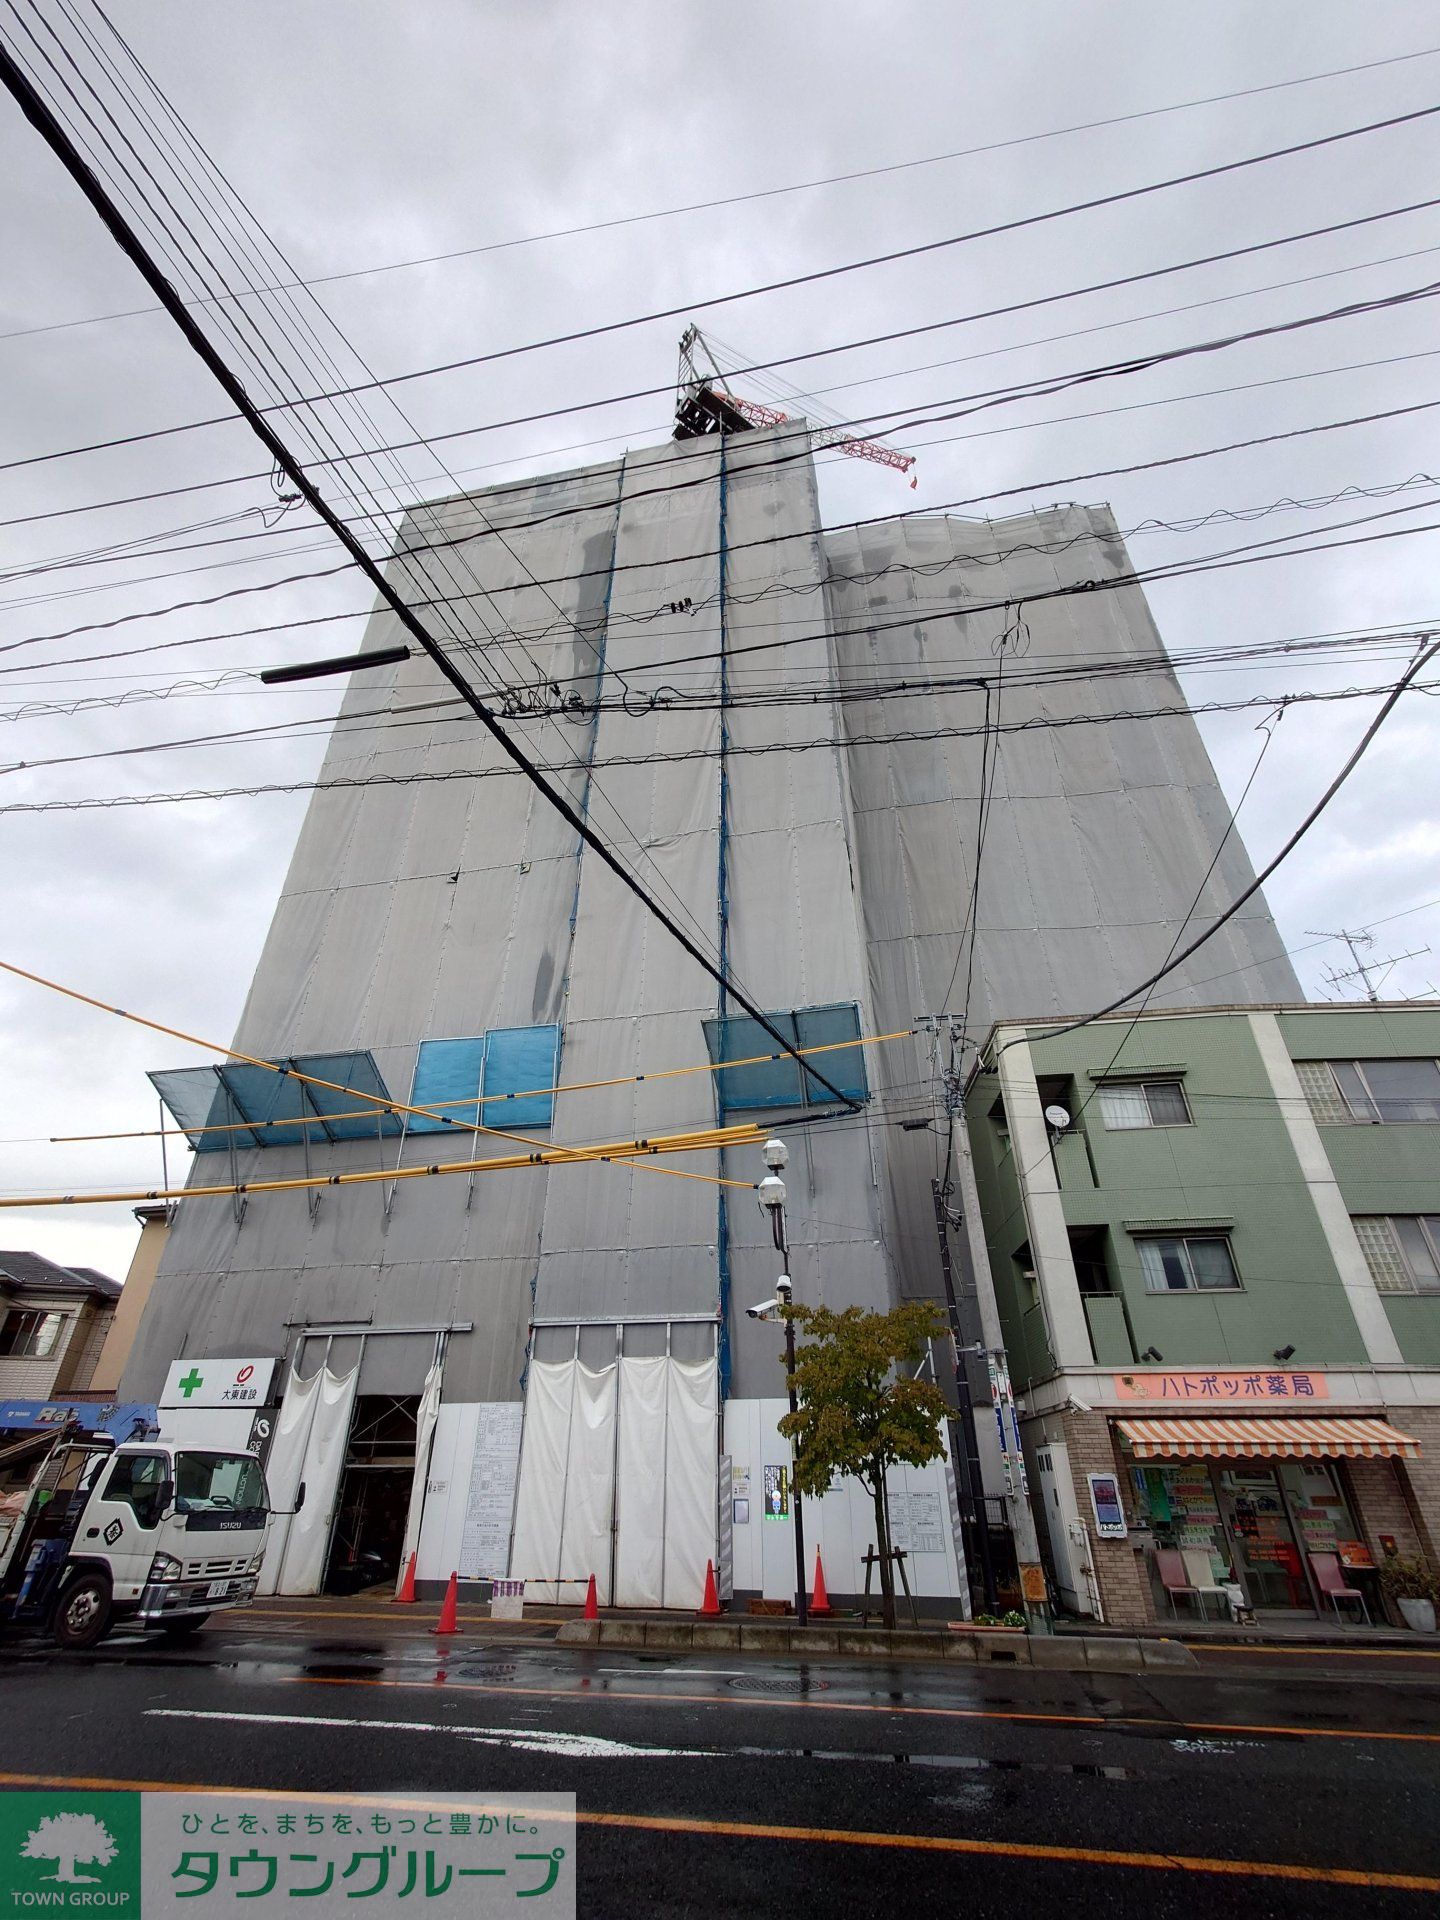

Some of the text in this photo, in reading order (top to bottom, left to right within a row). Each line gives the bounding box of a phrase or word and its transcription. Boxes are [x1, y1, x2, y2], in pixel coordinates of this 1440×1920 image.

[1161, 1374, 1315, 1397] ハトポッポ薬局
[221, 1389, 257, 1401] 大東建設
[219, 1522, 242, 1530] ISUZU
